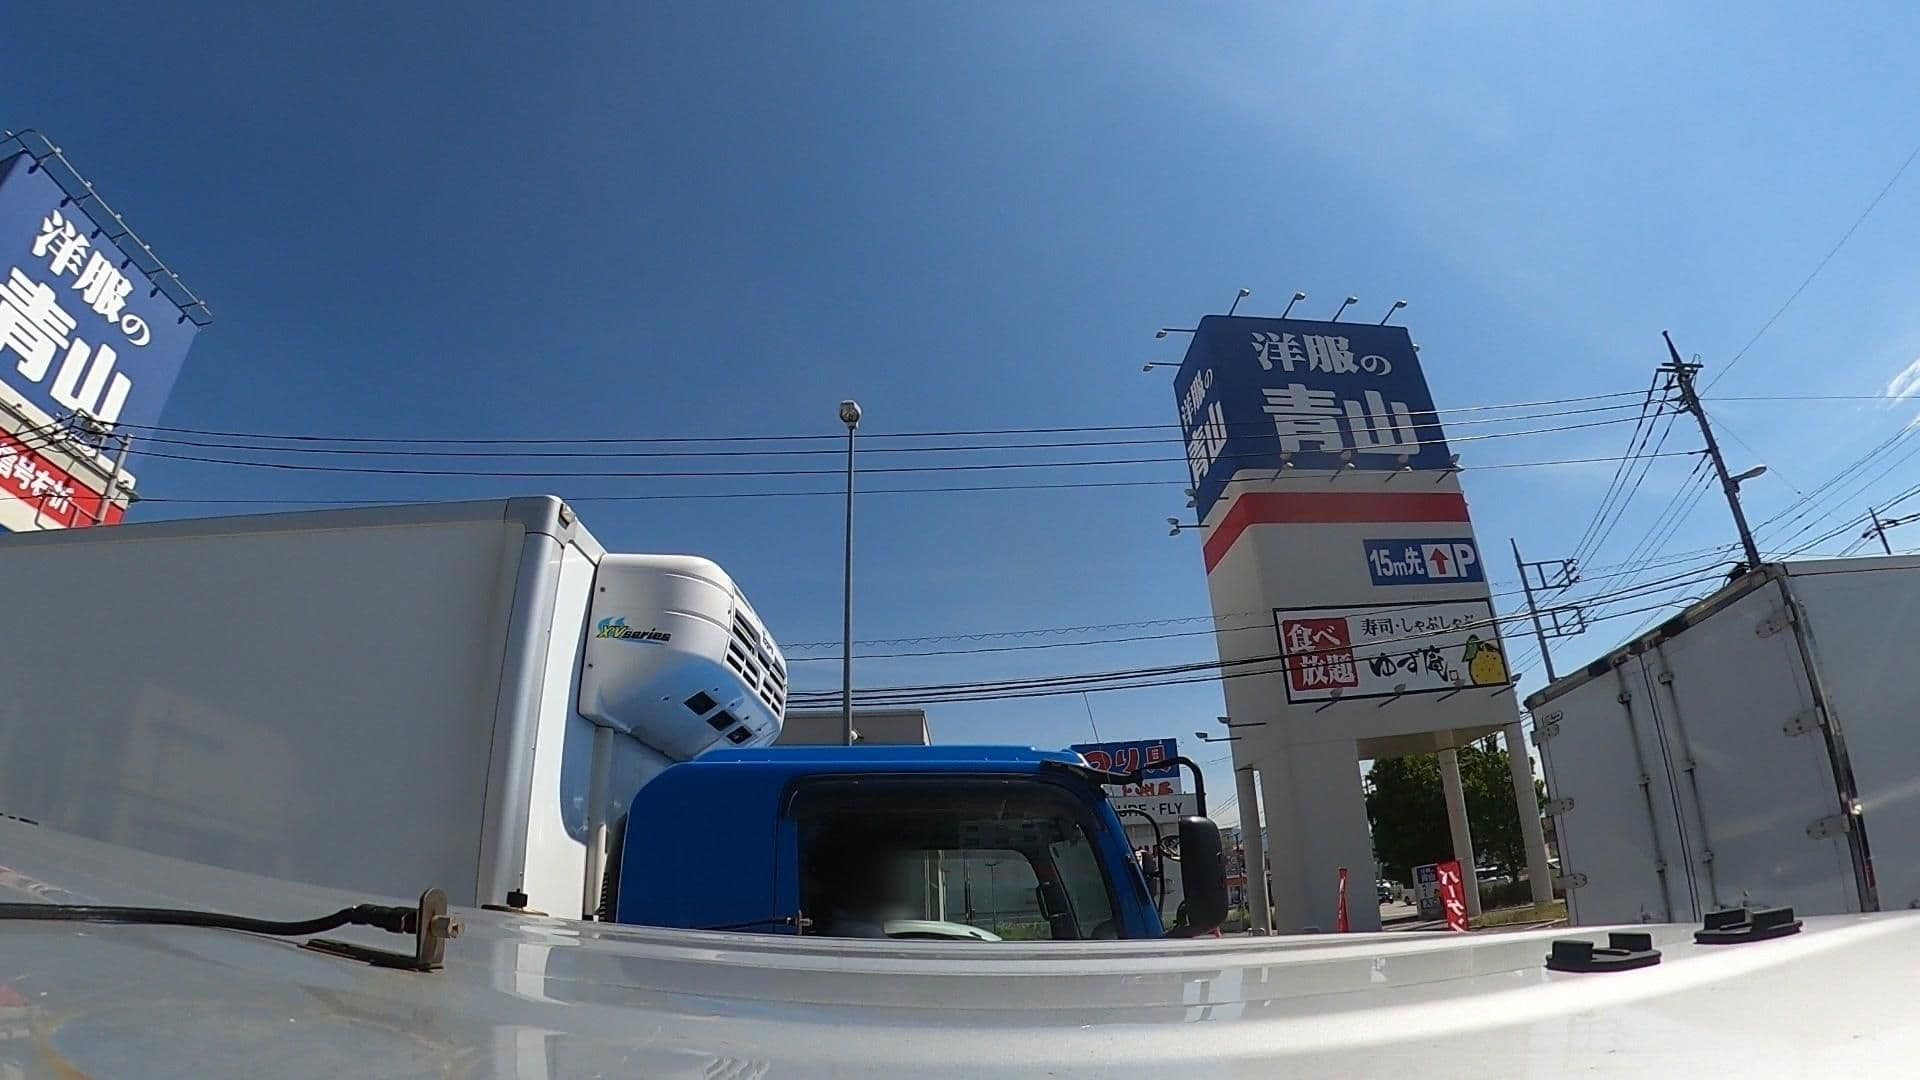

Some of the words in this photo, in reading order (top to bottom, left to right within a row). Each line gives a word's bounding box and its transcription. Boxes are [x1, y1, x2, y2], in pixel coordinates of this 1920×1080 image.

[32, 209, 151, 347] 洋服の
[0, 266, 133, 433] 青山
[1251, 331, 1393, 377] 洋服の
[1181, 367, 1214, 433] 洋服の
[1262, 382, 1421, 456] 青山
[1187, 399, 1228, 491] 青山
[1370, 546, 1425, 578] 15m先
[1457, 542, 1477, 578] P
[1287, 622, 1342, 653] 食べ
[1300, 650, 1356, 687] 放題
[1368, 644, 1449, 683] ゆず庵
[1160, 802, 1183, 816] FLY
